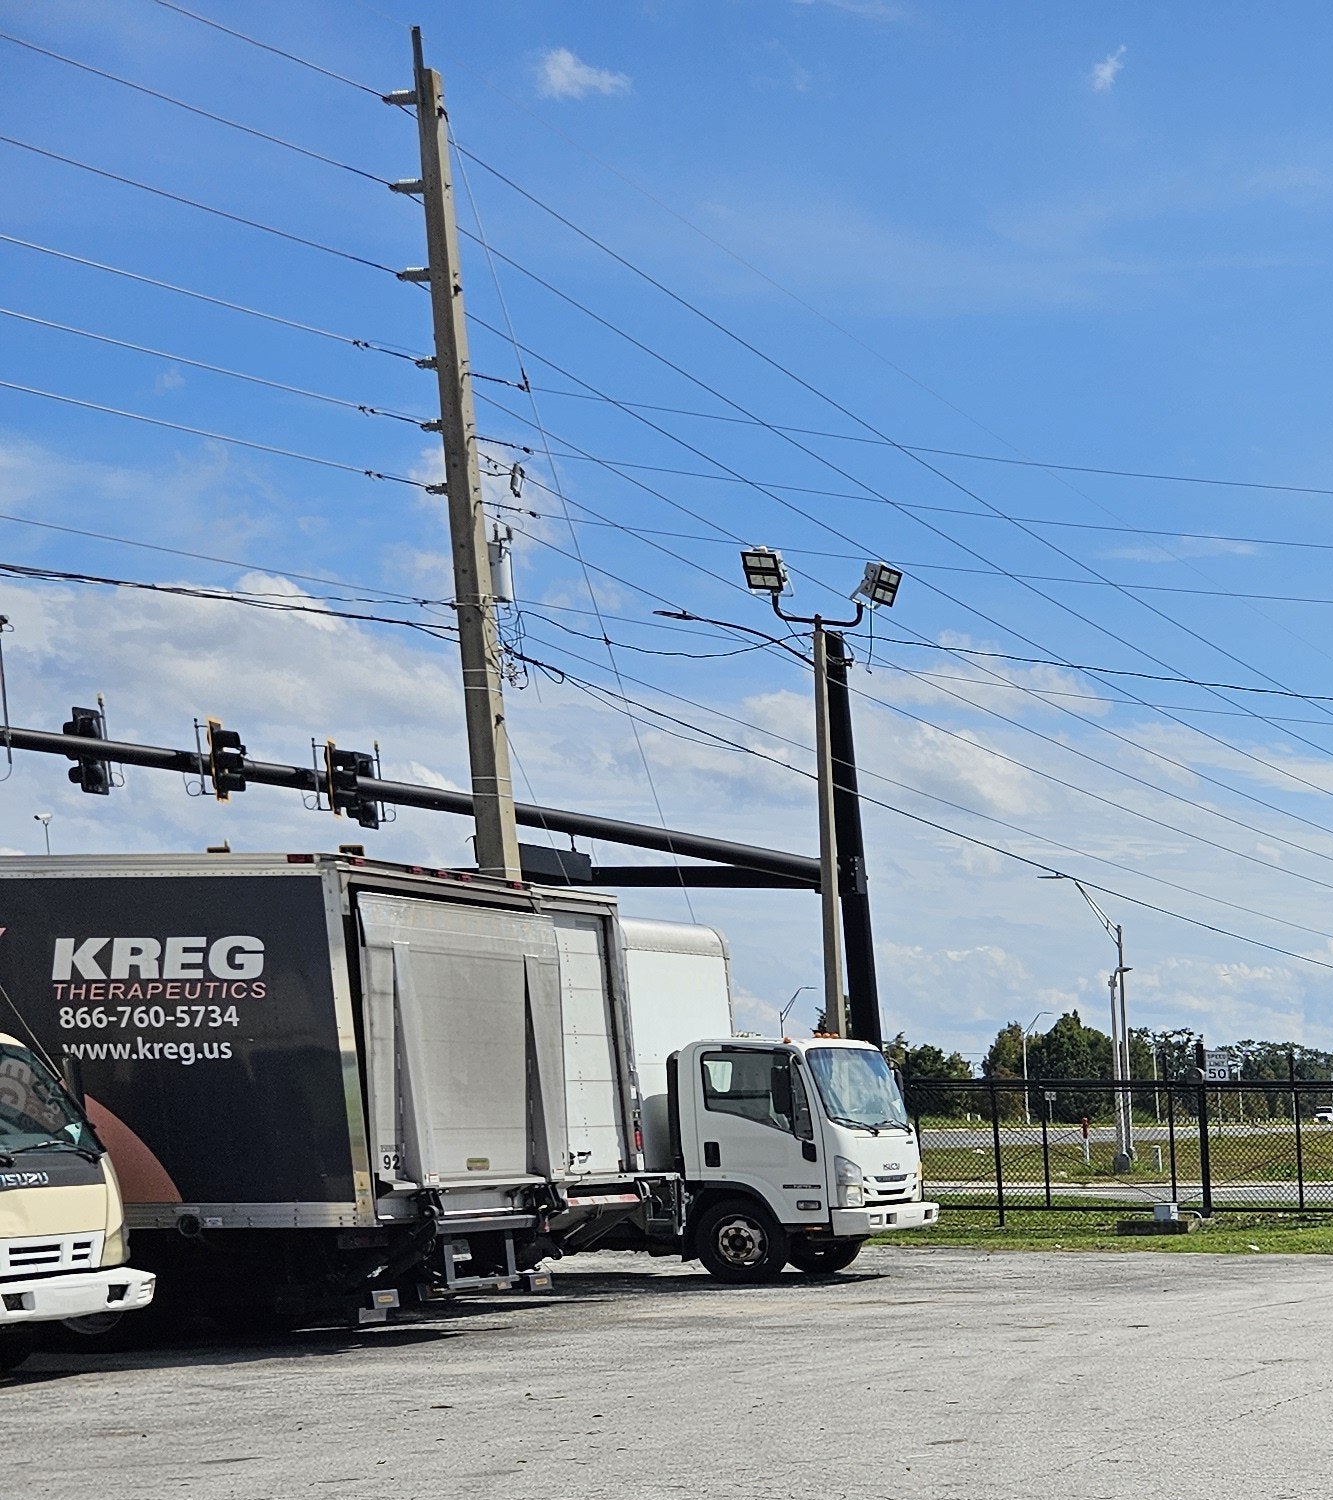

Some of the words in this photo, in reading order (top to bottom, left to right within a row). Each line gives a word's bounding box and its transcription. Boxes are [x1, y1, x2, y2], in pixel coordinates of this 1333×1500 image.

[52, 935, 265, 981] KREG
[53, 982, 267, 1000] THERAPEUTICS
[59, 1005, 240, 1028] 866-760-5734
[62, 1037, 233, 1065] www.kreg.us
[1208, 1068, 1227, 1079] 50
[383, 1154, 400, 1170] 92
